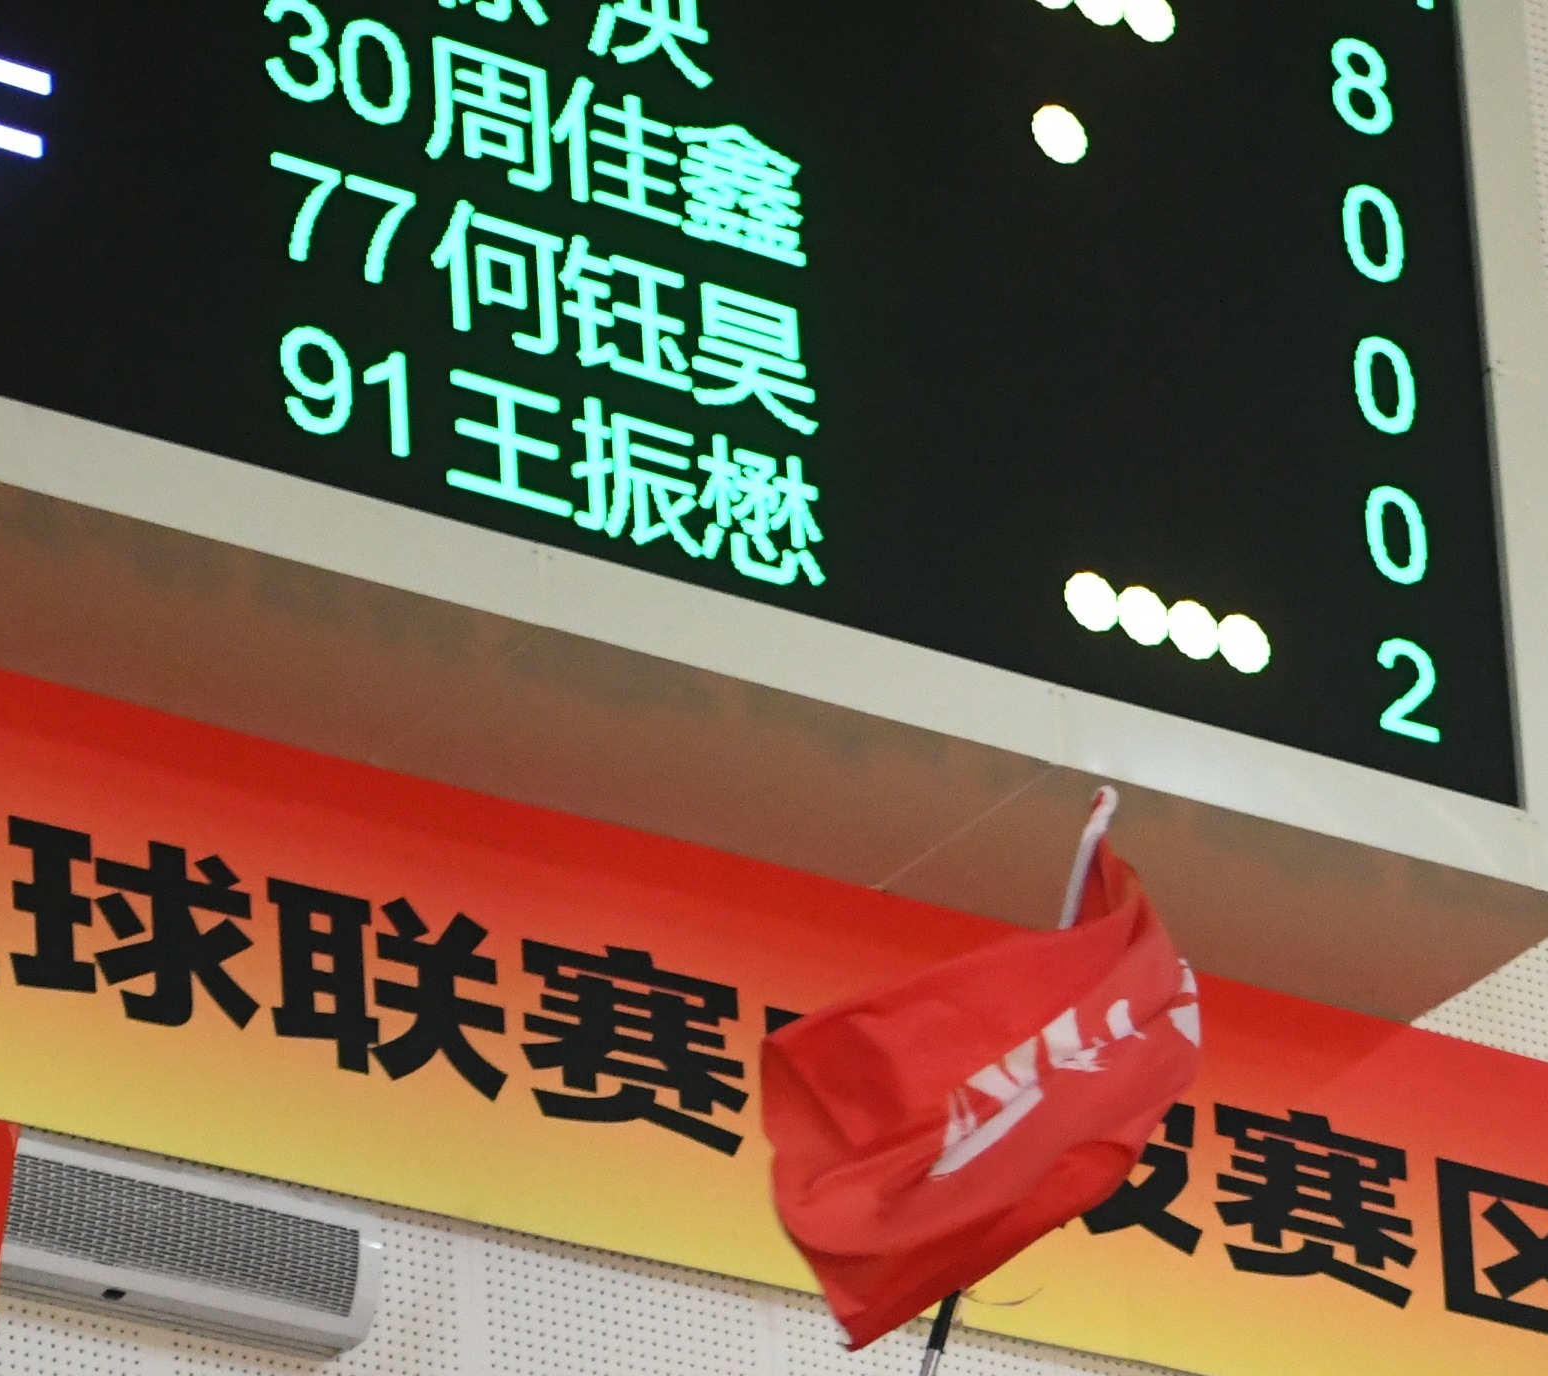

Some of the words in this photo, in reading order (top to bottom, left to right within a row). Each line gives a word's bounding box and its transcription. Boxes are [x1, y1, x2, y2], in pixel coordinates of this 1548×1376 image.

[264, 0, 410, 125] 30
[425, 36, 806, 267] 周佳鑫
[1342, 184, 1404, 282] 0
[1331, 38, 1393, 134] 8
[270, 150, 417, 285] 77
[431, 199, 818, 435] 何钰昊
[1354, 336, 1416, 434] 0
[280, 326, 410, 458] 91
[446, 368, 826, 587] 王振懋
[1365, 486, 1427, 584] 0
[1377, 638, 1440, 743] 2
